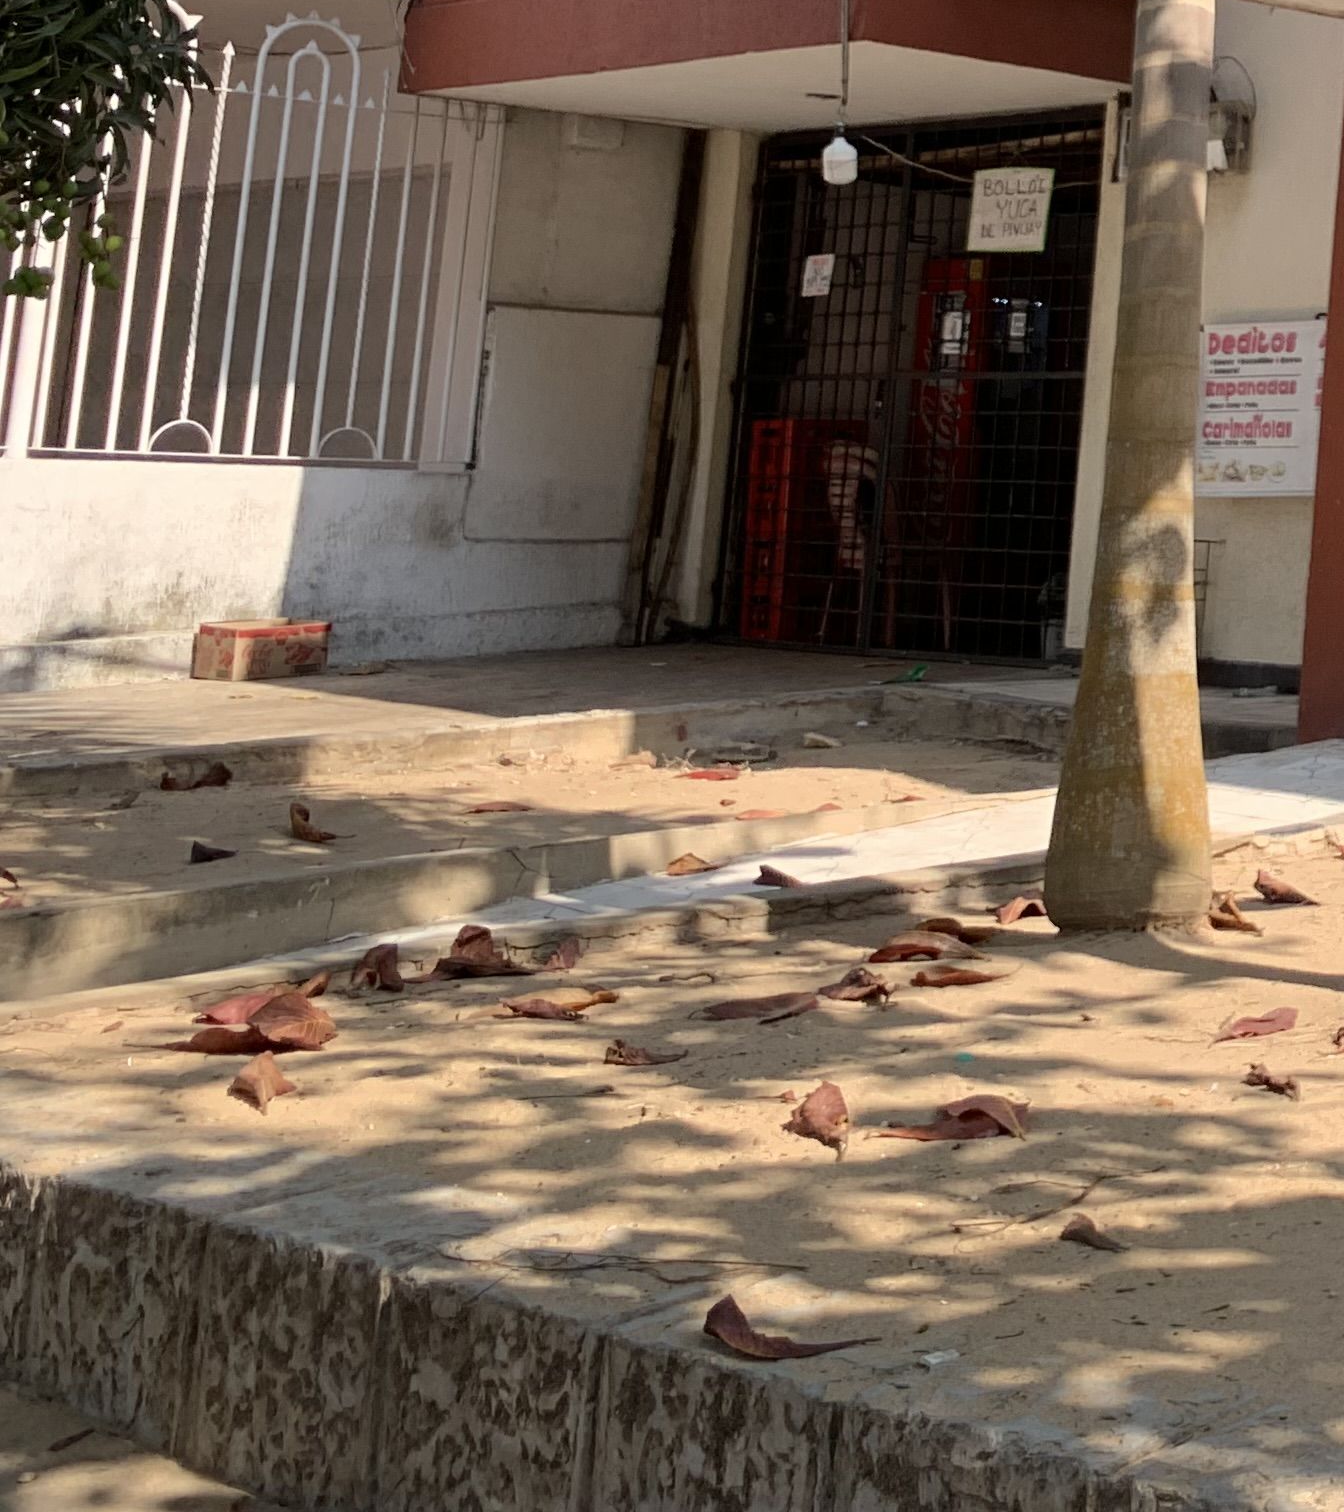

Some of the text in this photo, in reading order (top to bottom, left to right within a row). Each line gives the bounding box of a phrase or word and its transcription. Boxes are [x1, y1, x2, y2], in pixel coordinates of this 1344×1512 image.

[996, 198, 1037, 219] YUCA
[1207, 326, 1298, 356] Deditos
[1205, 379, 1297, 401] Empanadas
